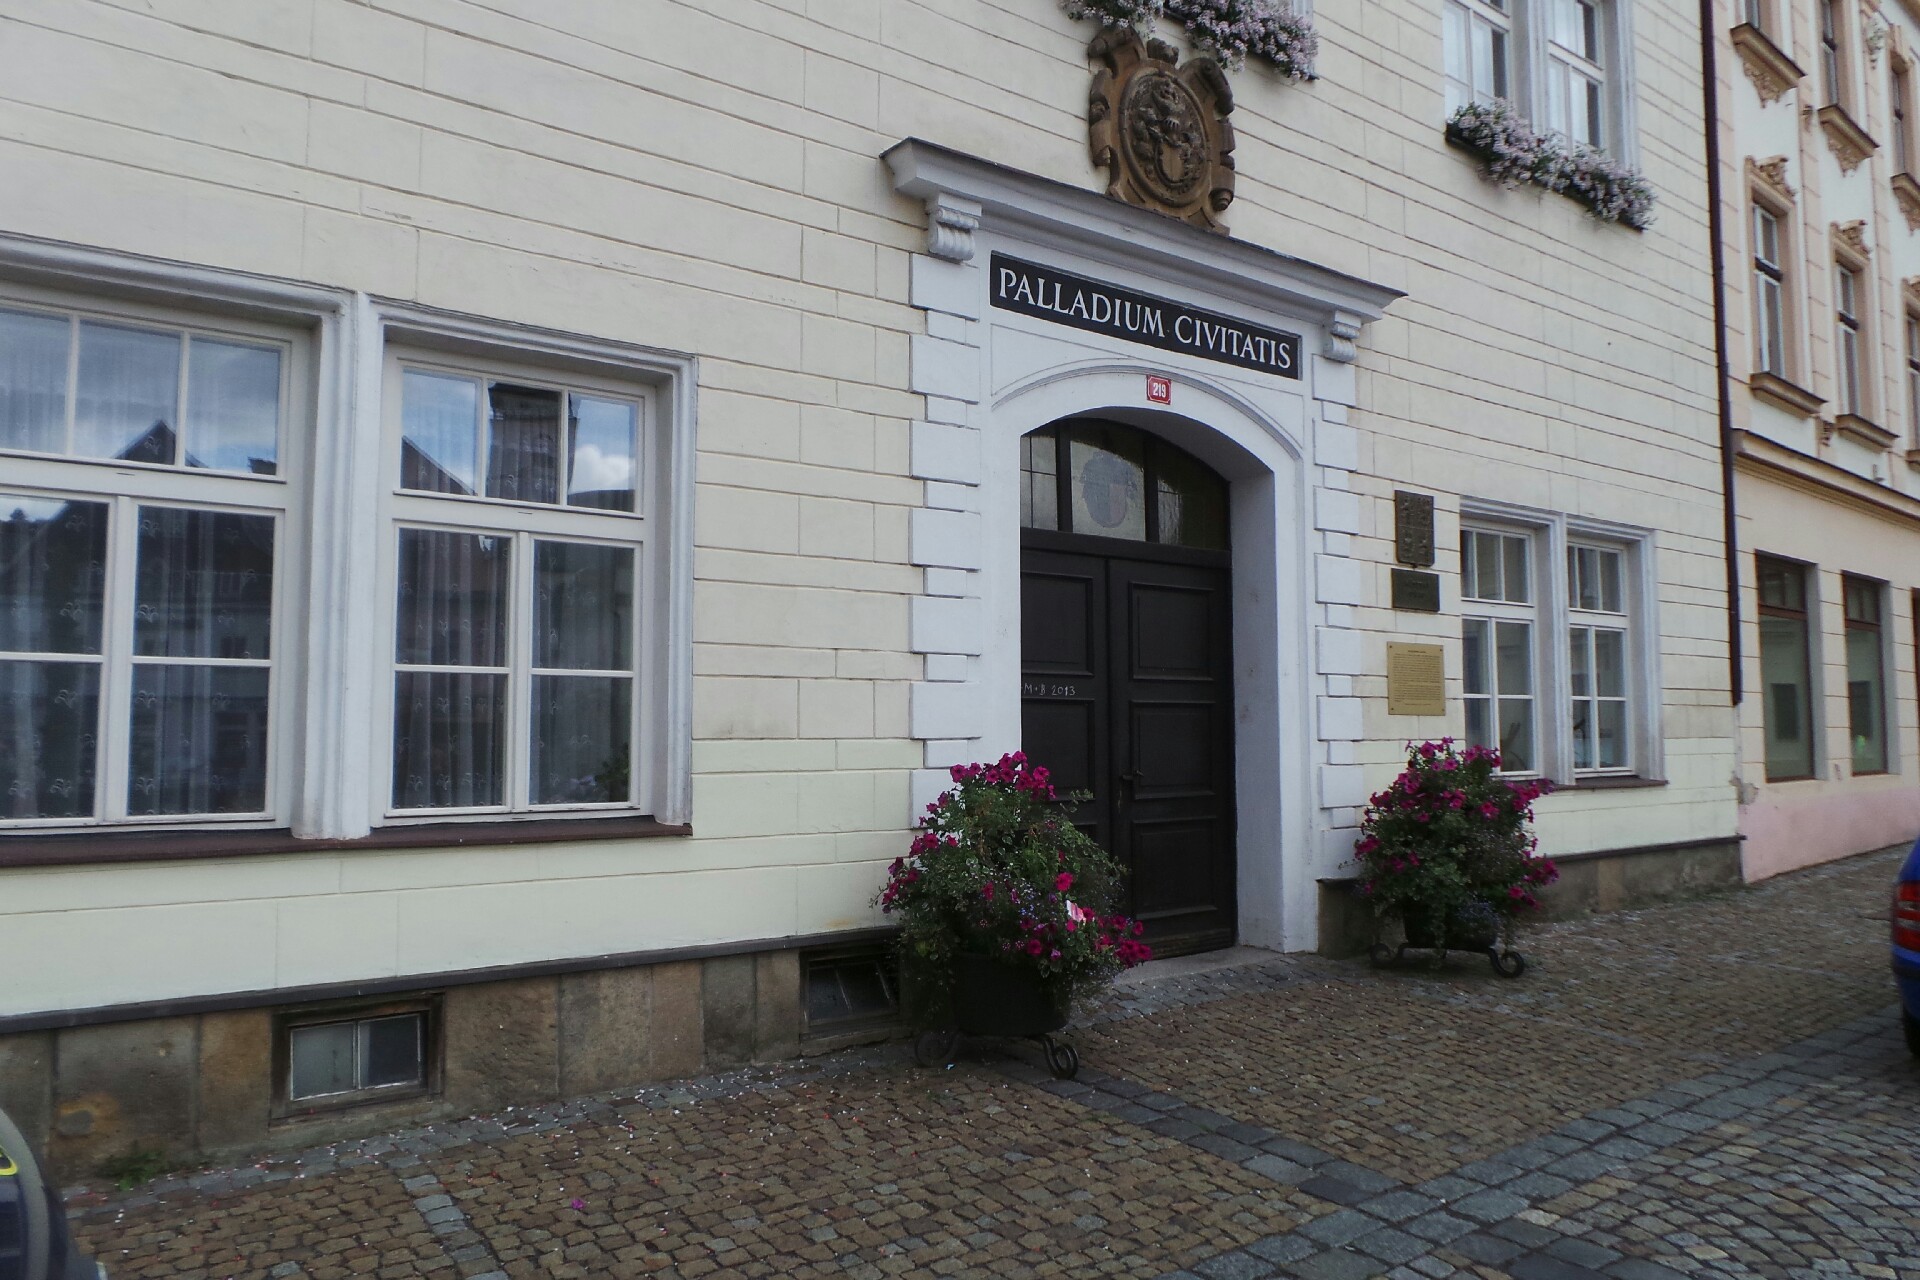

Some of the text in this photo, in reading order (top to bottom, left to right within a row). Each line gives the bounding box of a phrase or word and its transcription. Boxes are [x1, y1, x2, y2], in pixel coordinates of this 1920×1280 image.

[999, 267, 1291, 369] PALLADIUM CIVITATIS
[1152, 382, 1167, 398] 219
[1051, 684, 1076, 697] 2013
